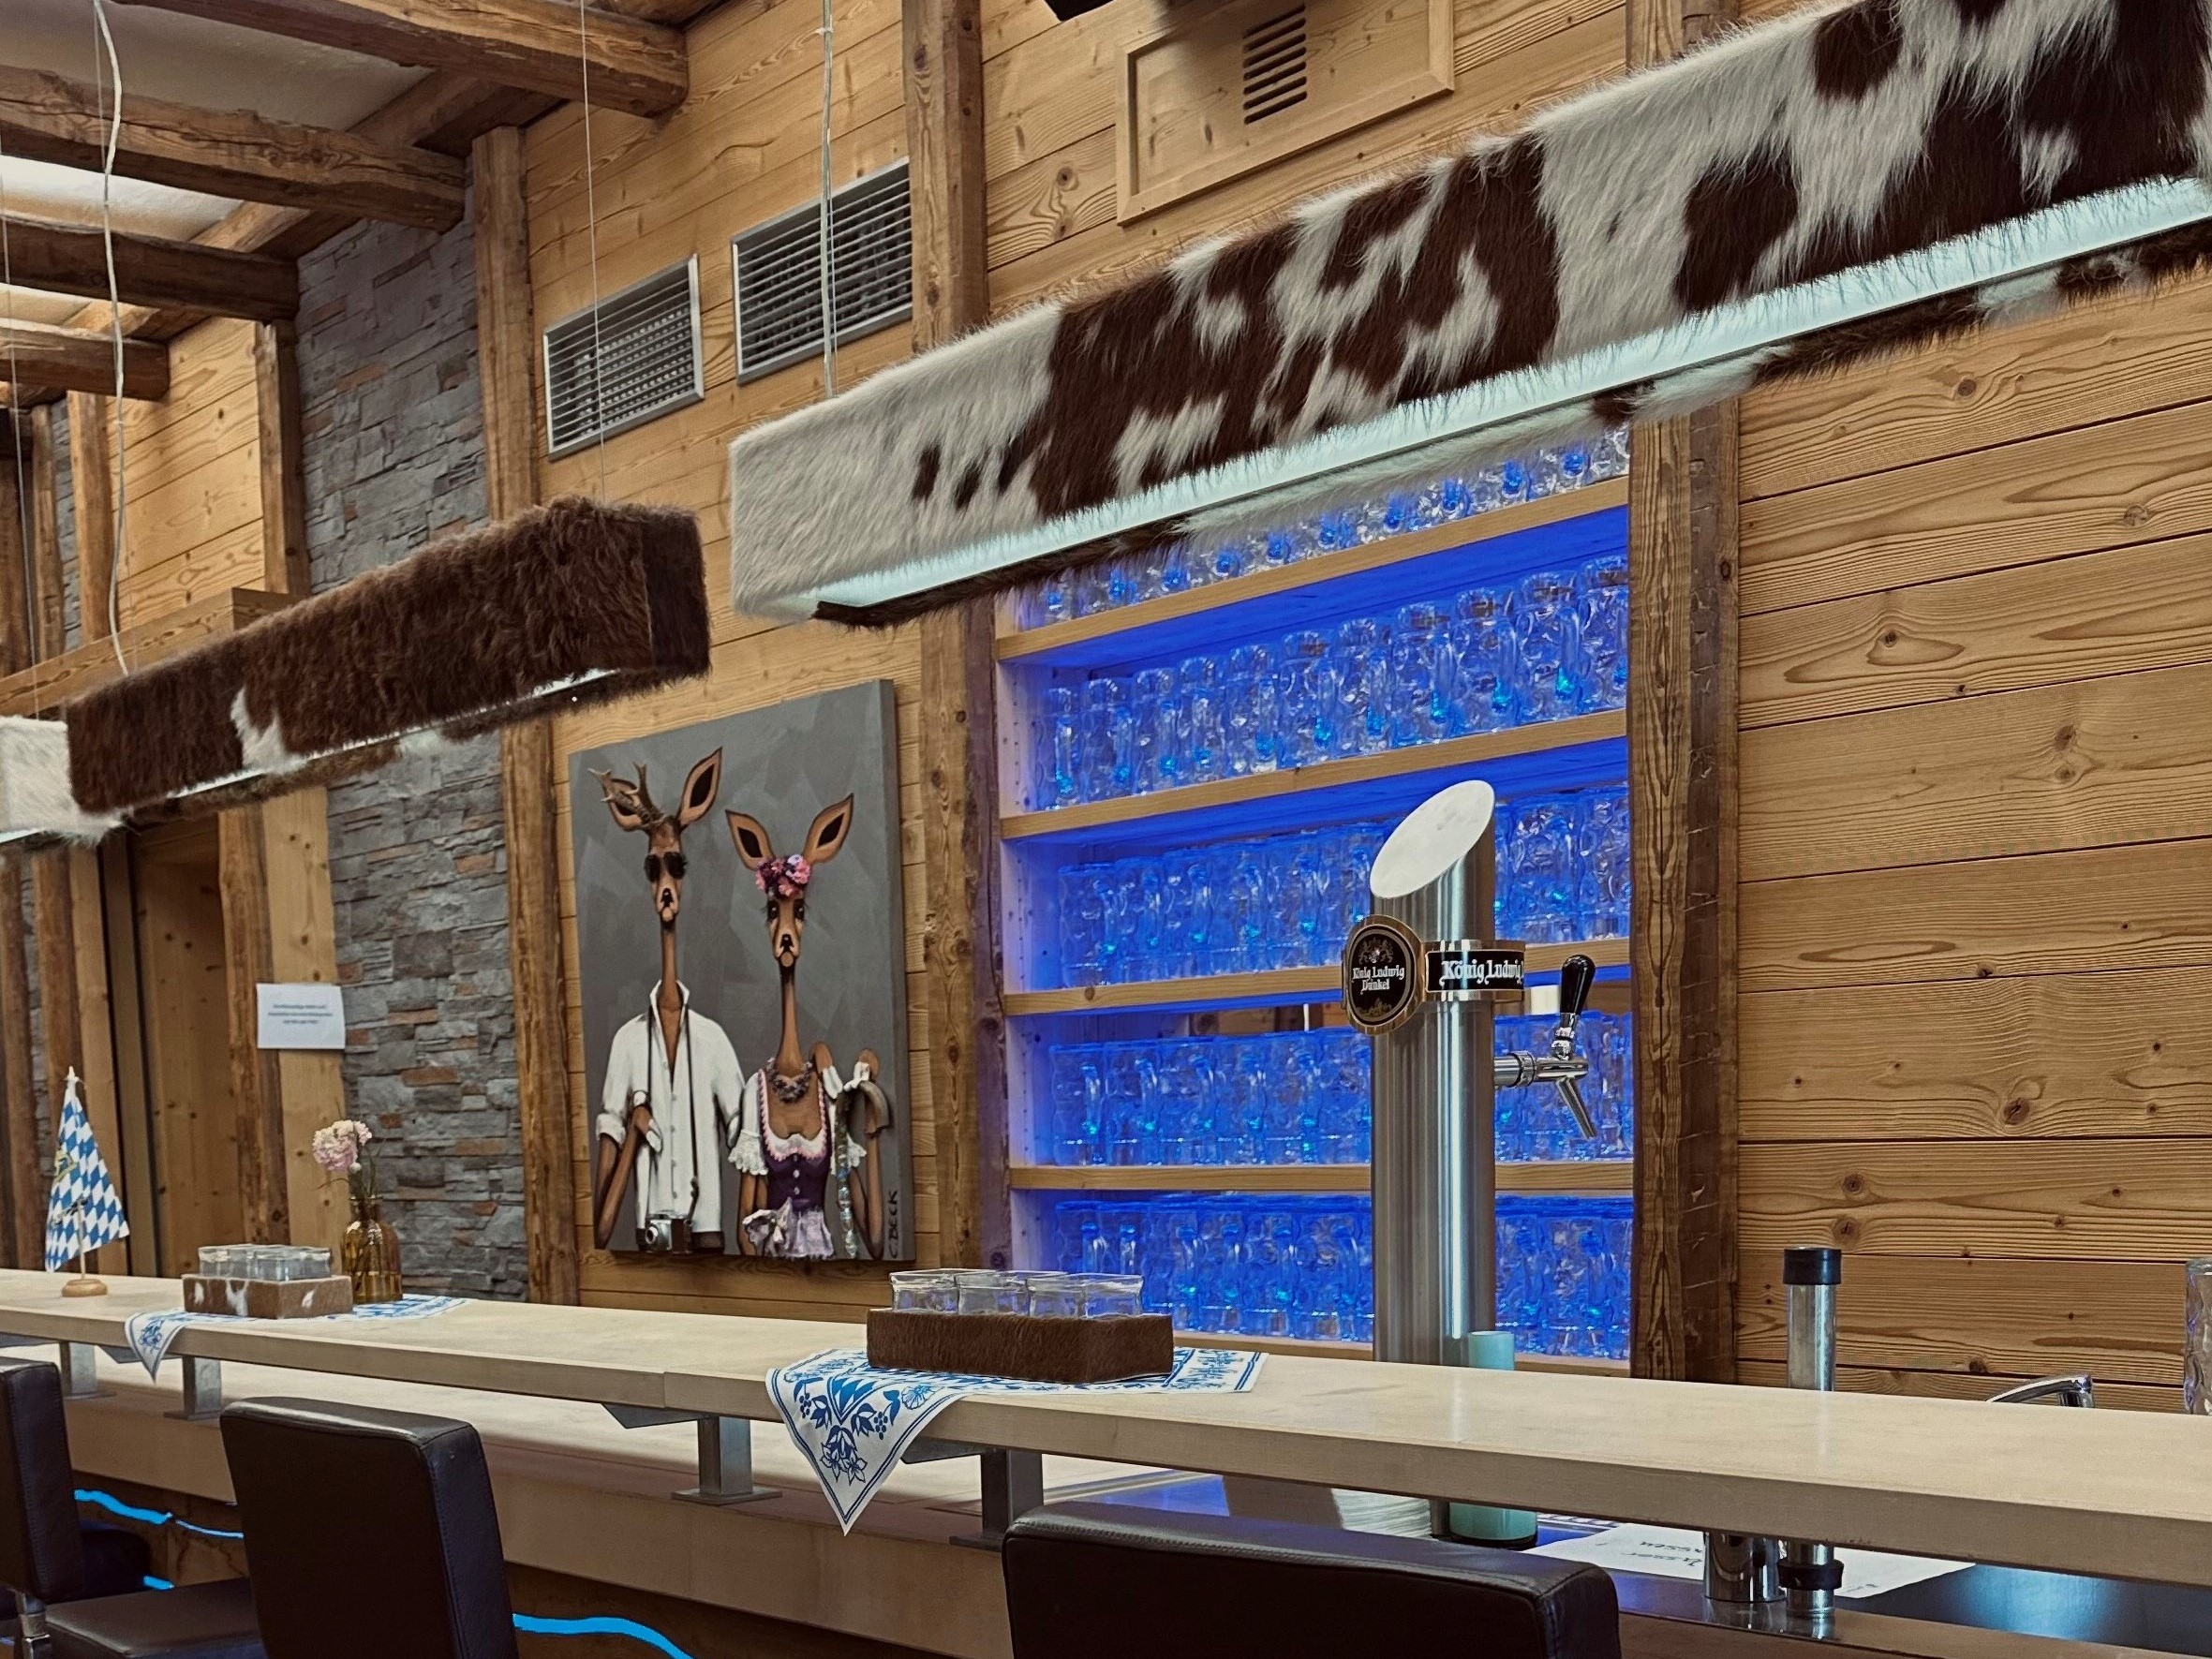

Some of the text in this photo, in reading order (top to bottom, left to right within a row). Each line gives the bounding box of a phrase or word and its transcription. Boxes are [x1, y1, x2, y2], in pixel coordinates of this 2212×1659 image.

[1372, 965, 1404, 981] Ludwig
[1439, 959, 1523, 986] König Ludwig
[1360, 978, 1389, 995] Dunkel
